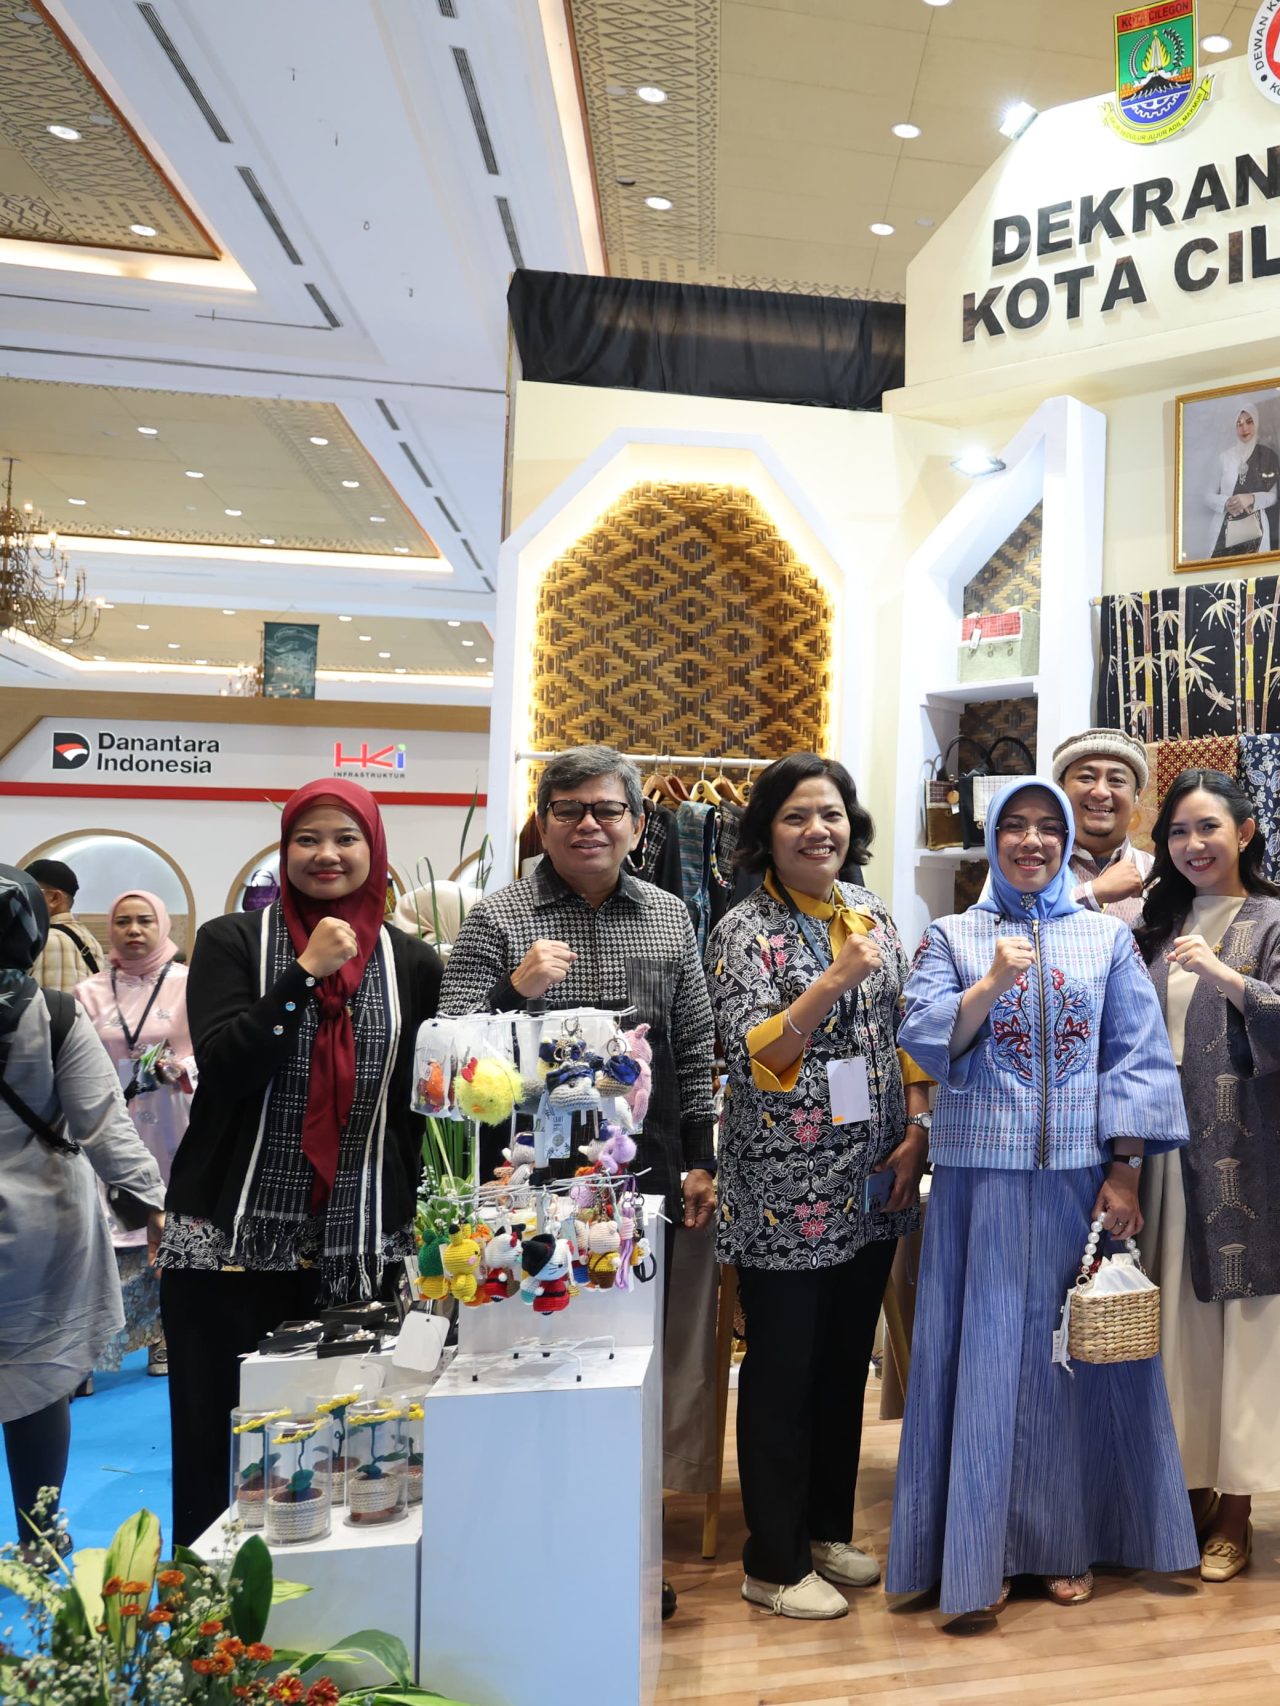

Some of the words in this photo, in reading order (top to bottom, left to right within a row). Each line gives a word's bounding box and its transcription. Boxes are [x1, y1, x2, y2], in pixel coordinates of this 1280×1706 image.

[1149, 2, 1189, 21] CILEGON
[1254, 16, 1269, 71] DEWAN
[962, 256, 1148, 343] KOTA
[98, 732, 220, 753] Danantara
[97, 753, 212, 773] Indonesia
